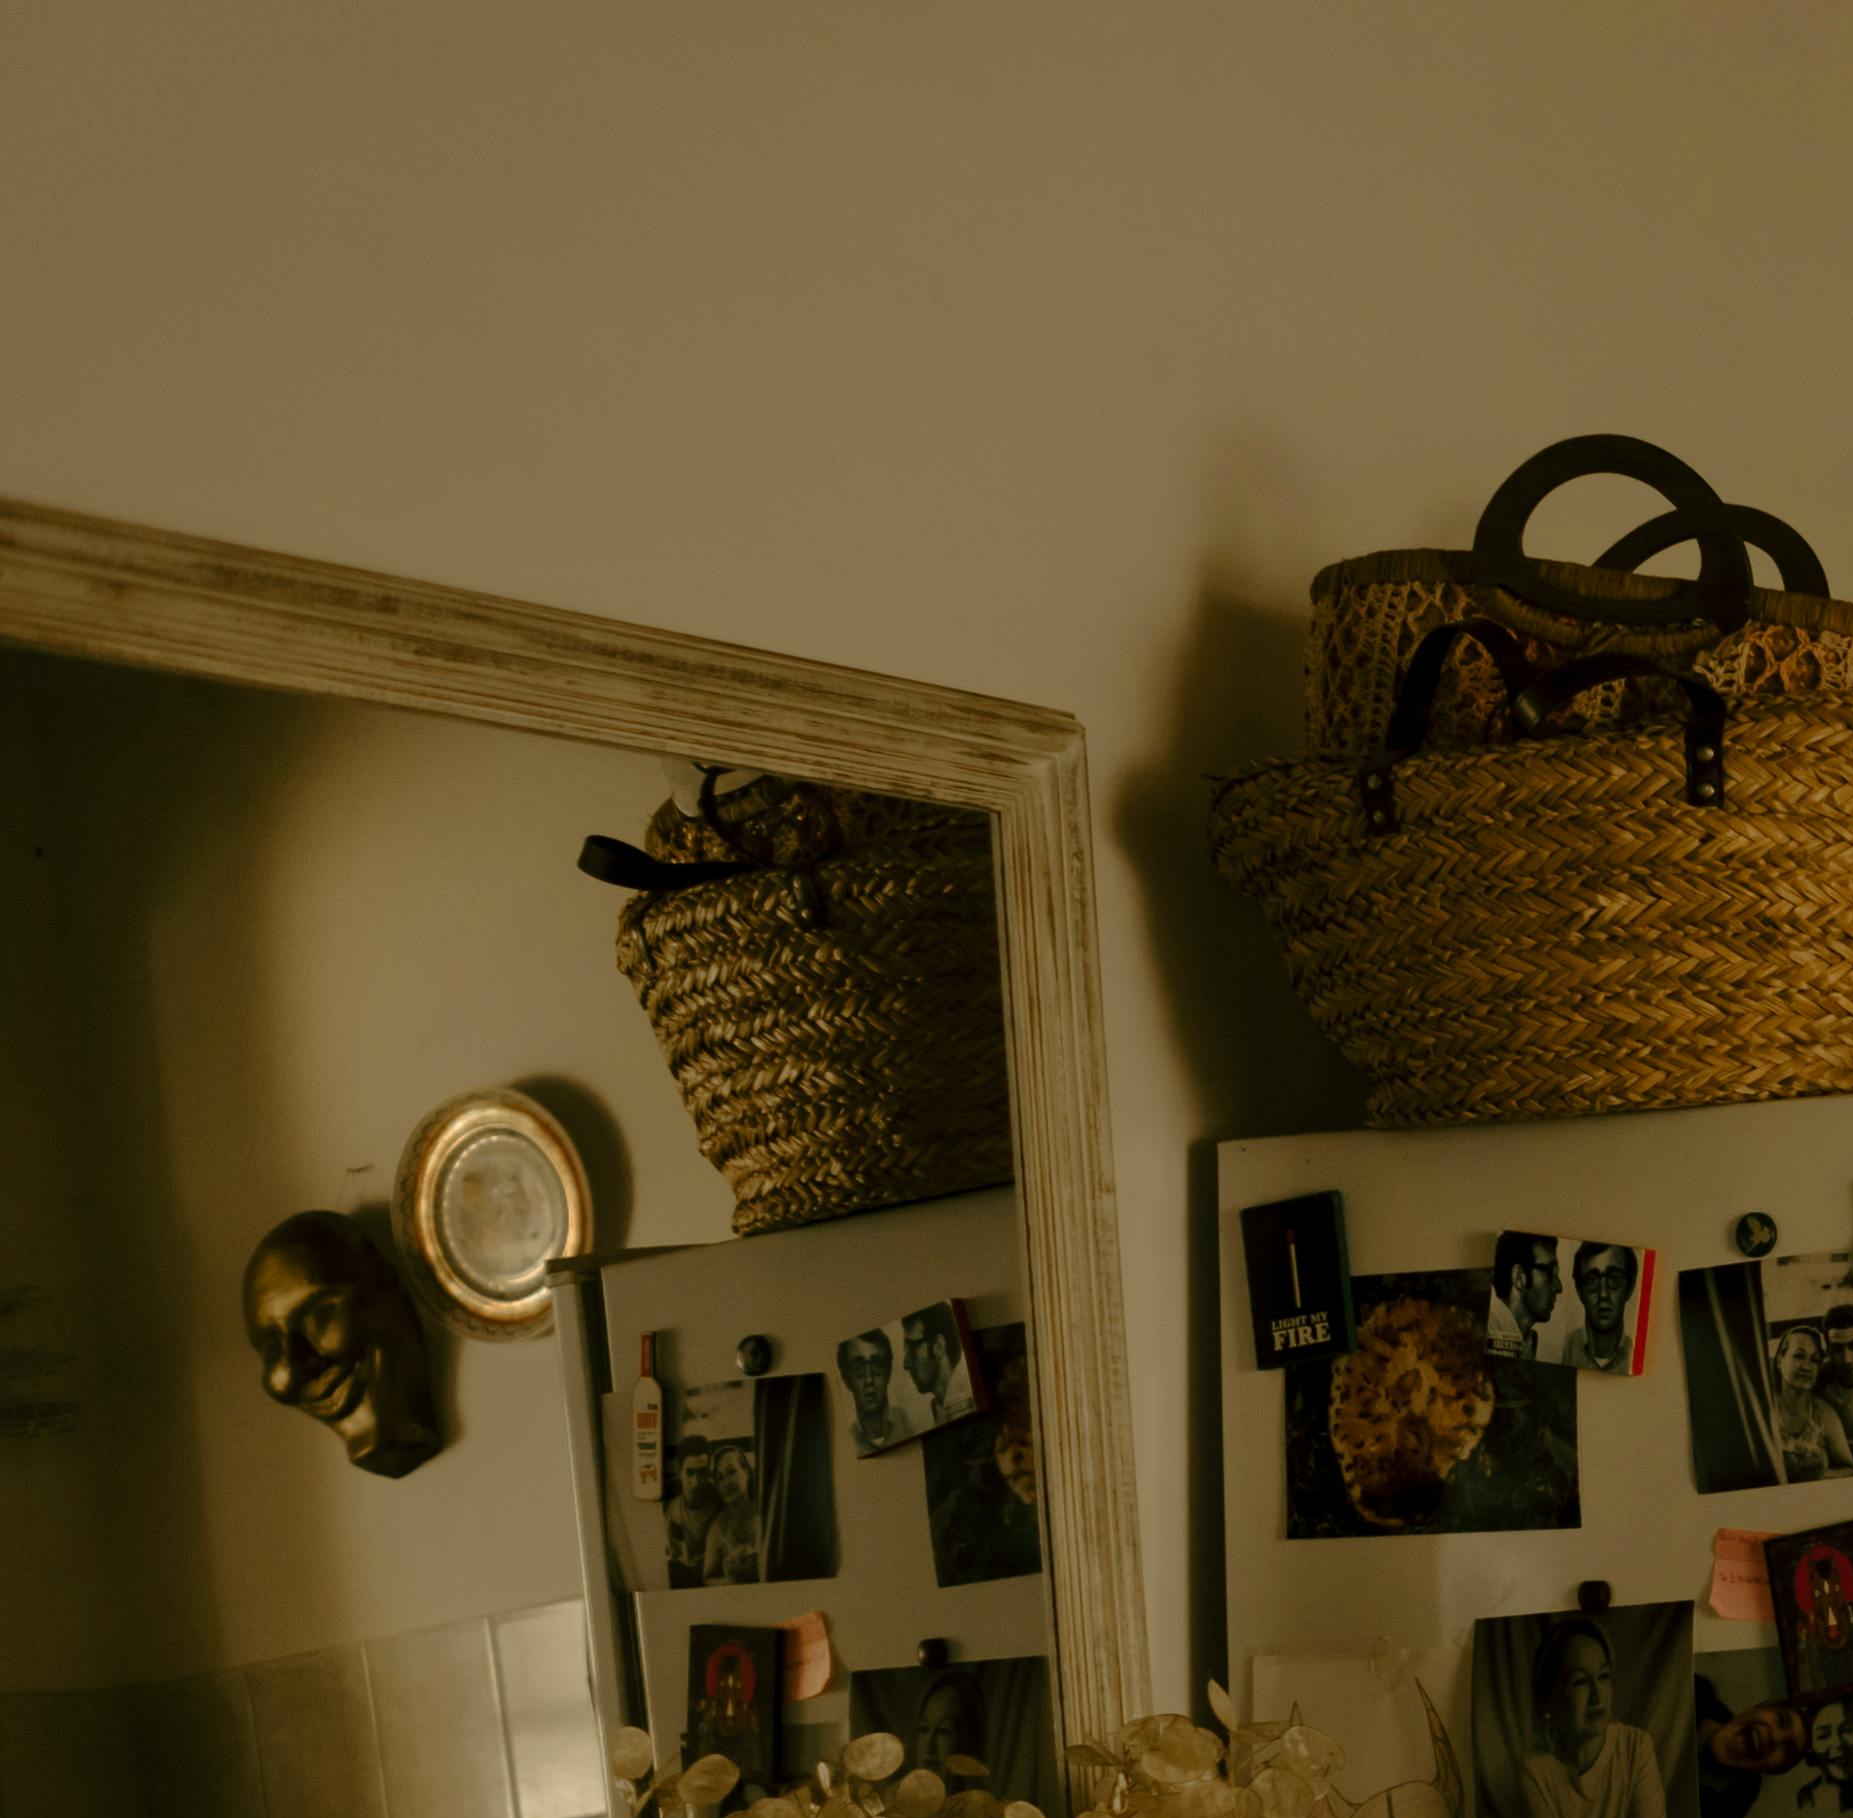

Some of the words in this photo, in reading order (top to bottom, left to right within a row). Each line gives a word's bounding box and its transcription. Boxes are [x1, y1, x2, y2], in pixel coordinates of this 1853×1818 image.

[1271, 1315, 1308, 1331] LIGHT
[1310, 1311, 1328, 1324] MY
[1272, 1321, 1331, 1352] FIRE
